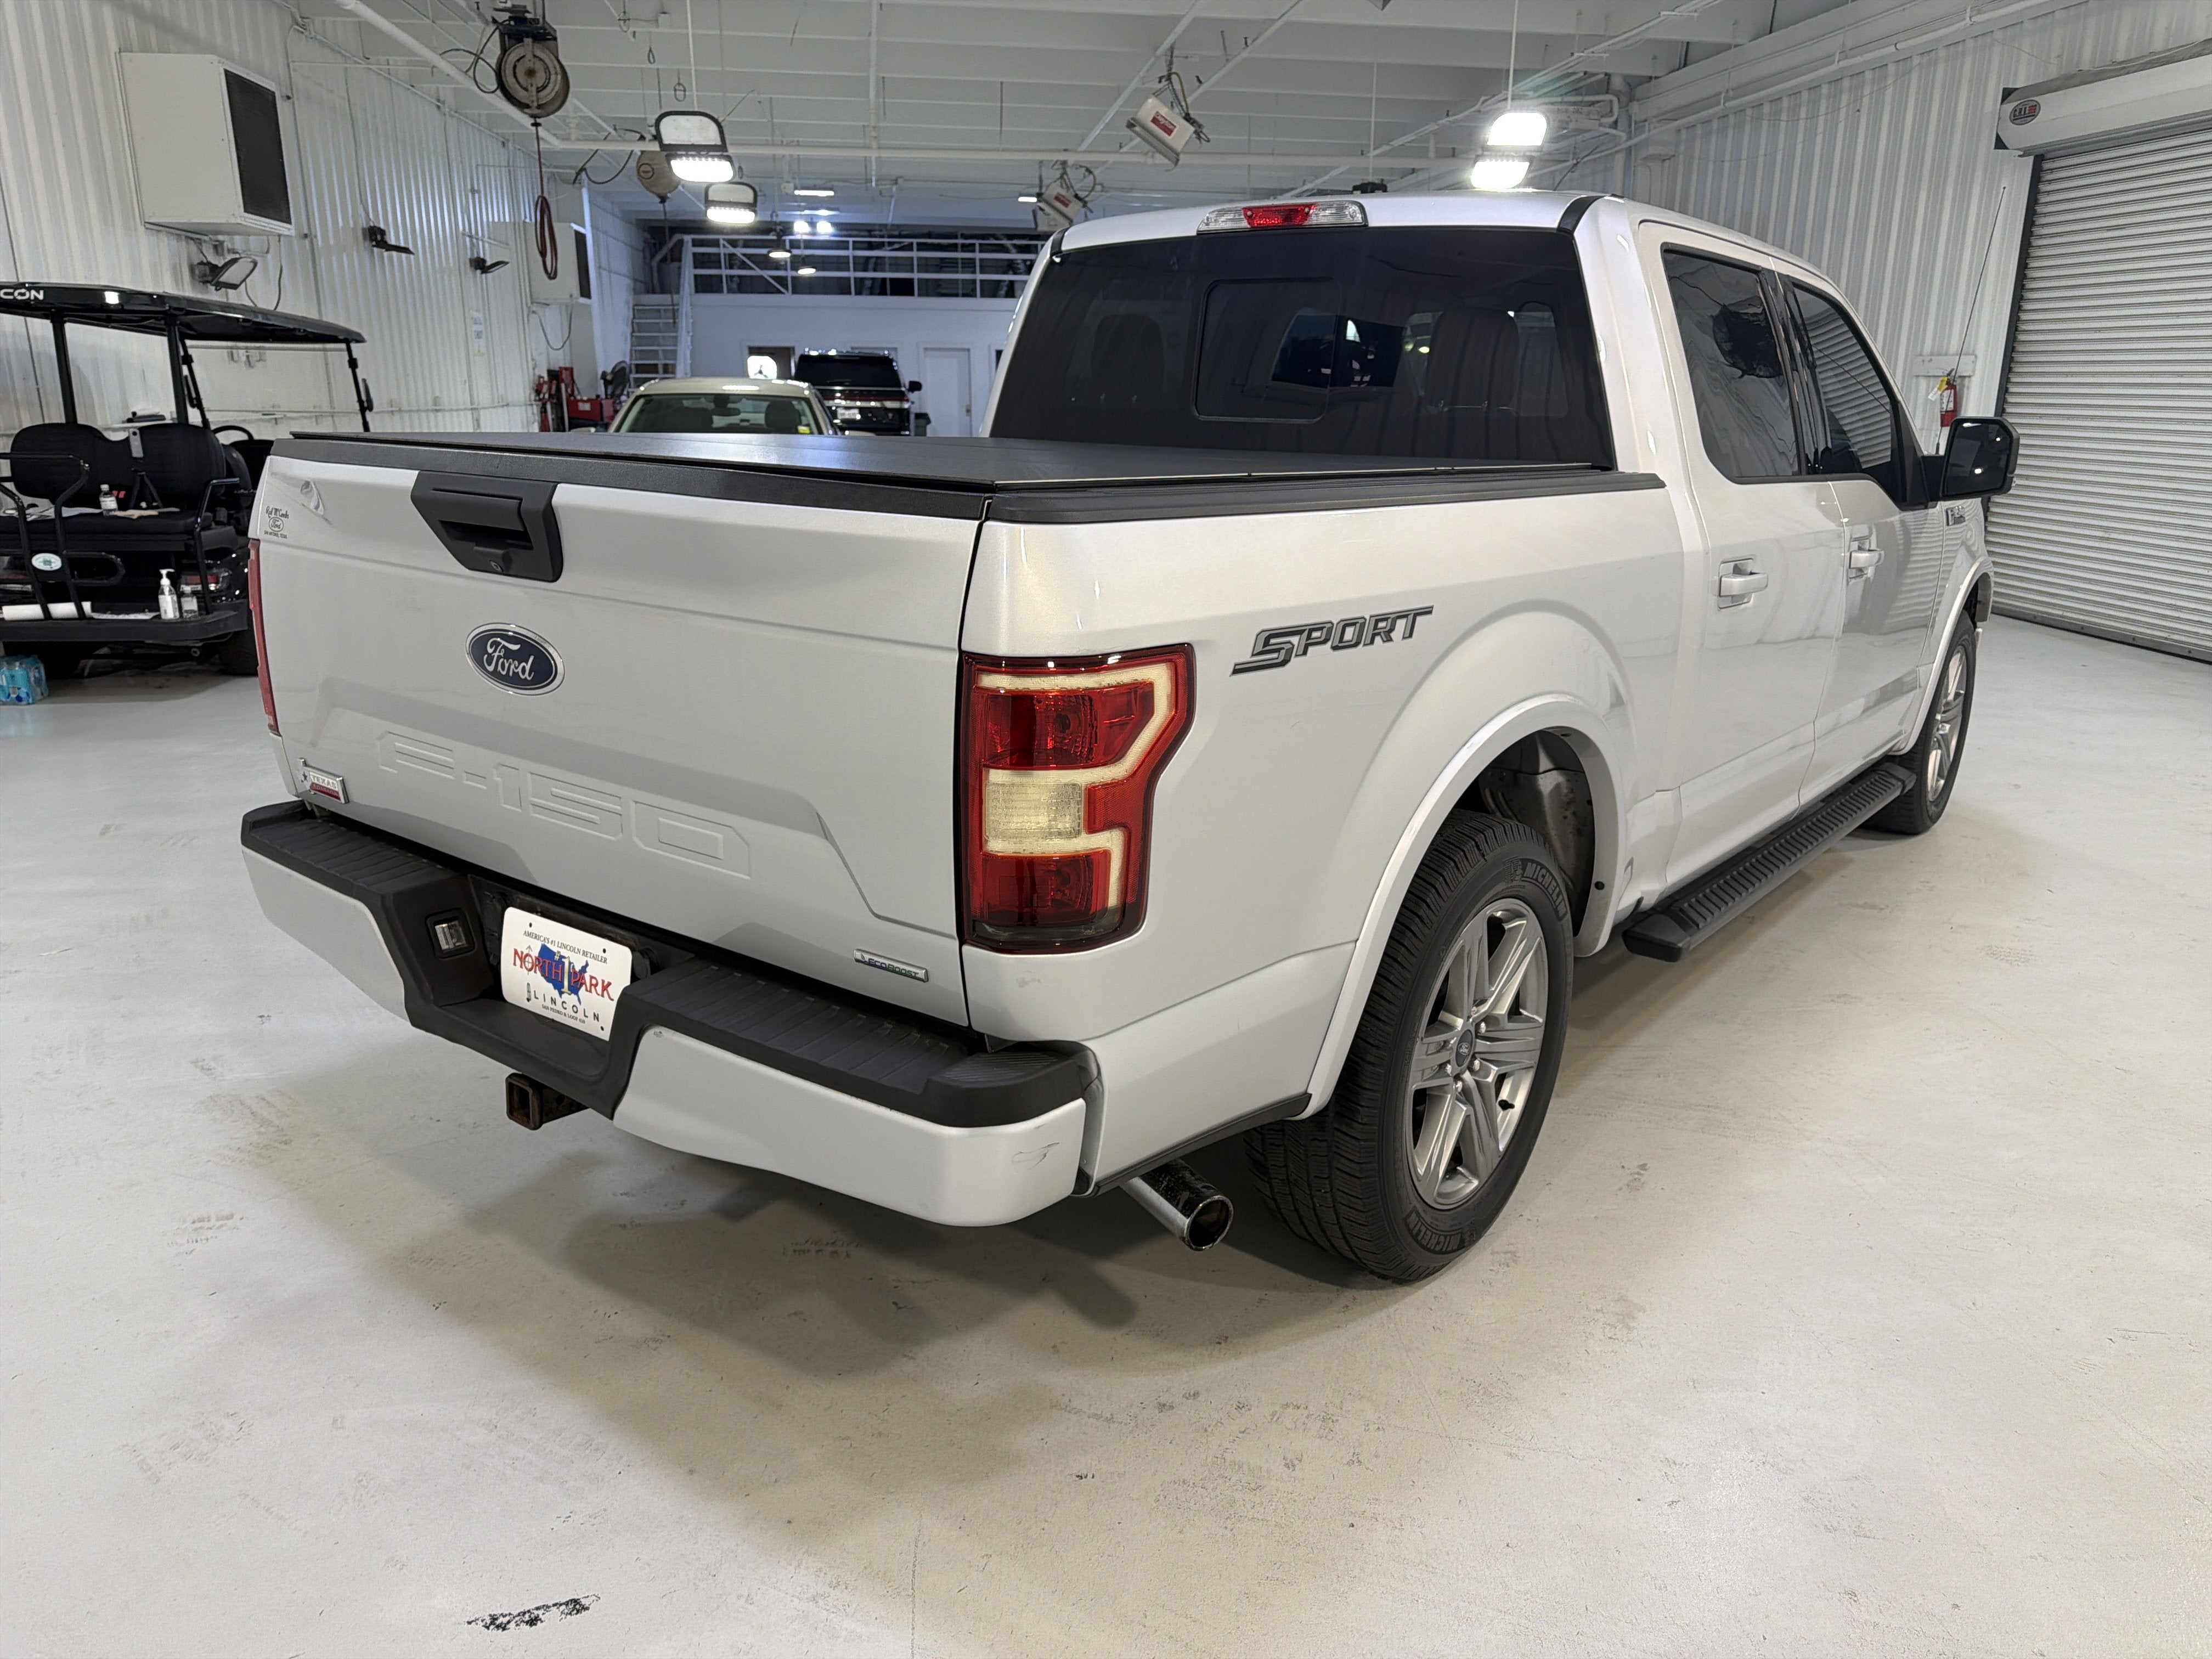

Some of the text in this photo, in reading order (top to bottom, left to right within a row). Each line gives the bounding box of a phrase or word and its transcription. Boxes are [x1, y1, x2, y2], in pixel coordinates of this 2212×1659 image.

[483, 637, 534, 680] Ford
[1229, 605, 1434, 677] SPORT
[376, 731, 751, 879] F-150
[1523, 861, 1566, 917] MICHELIN
[523, 930, 550, 944] AMERICA'S
[557, 941, 582, 955] LINCOLN
[582, 950, 608, 964] RETAILER
[513, 948, 614, 1001] NORTH PARK
[534, 990, 600, 1022] LINCOLN
[550, 1007, 563, 1015] PEDRO
[567, 1013, 579, 1022] LOOP
[1407, 1210, 1462, 1251] MICHELIN
